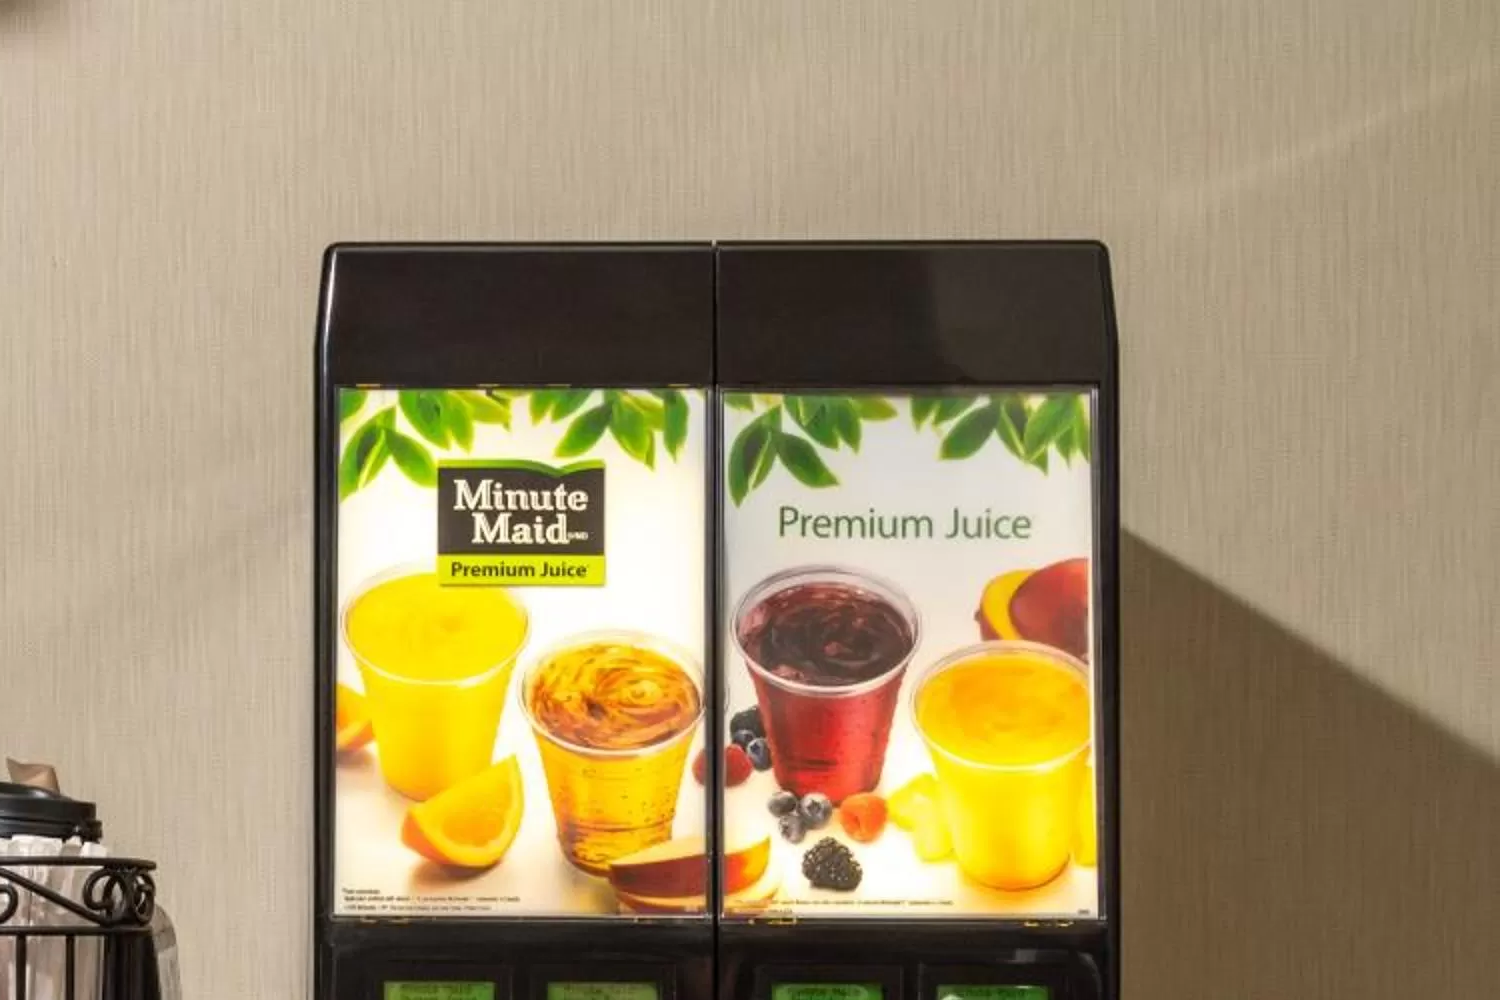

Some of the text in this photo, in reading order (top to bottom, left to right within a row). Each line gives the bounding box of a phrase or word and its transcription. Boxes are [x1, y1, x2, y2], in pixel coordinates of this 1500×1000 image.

[453, 479, 589, 511] Minute
[471, 511, 570, 545] Maid
[778, 506, 1032, 540] Premium Juice
[451, 561, 588, 578] Premium Juice
